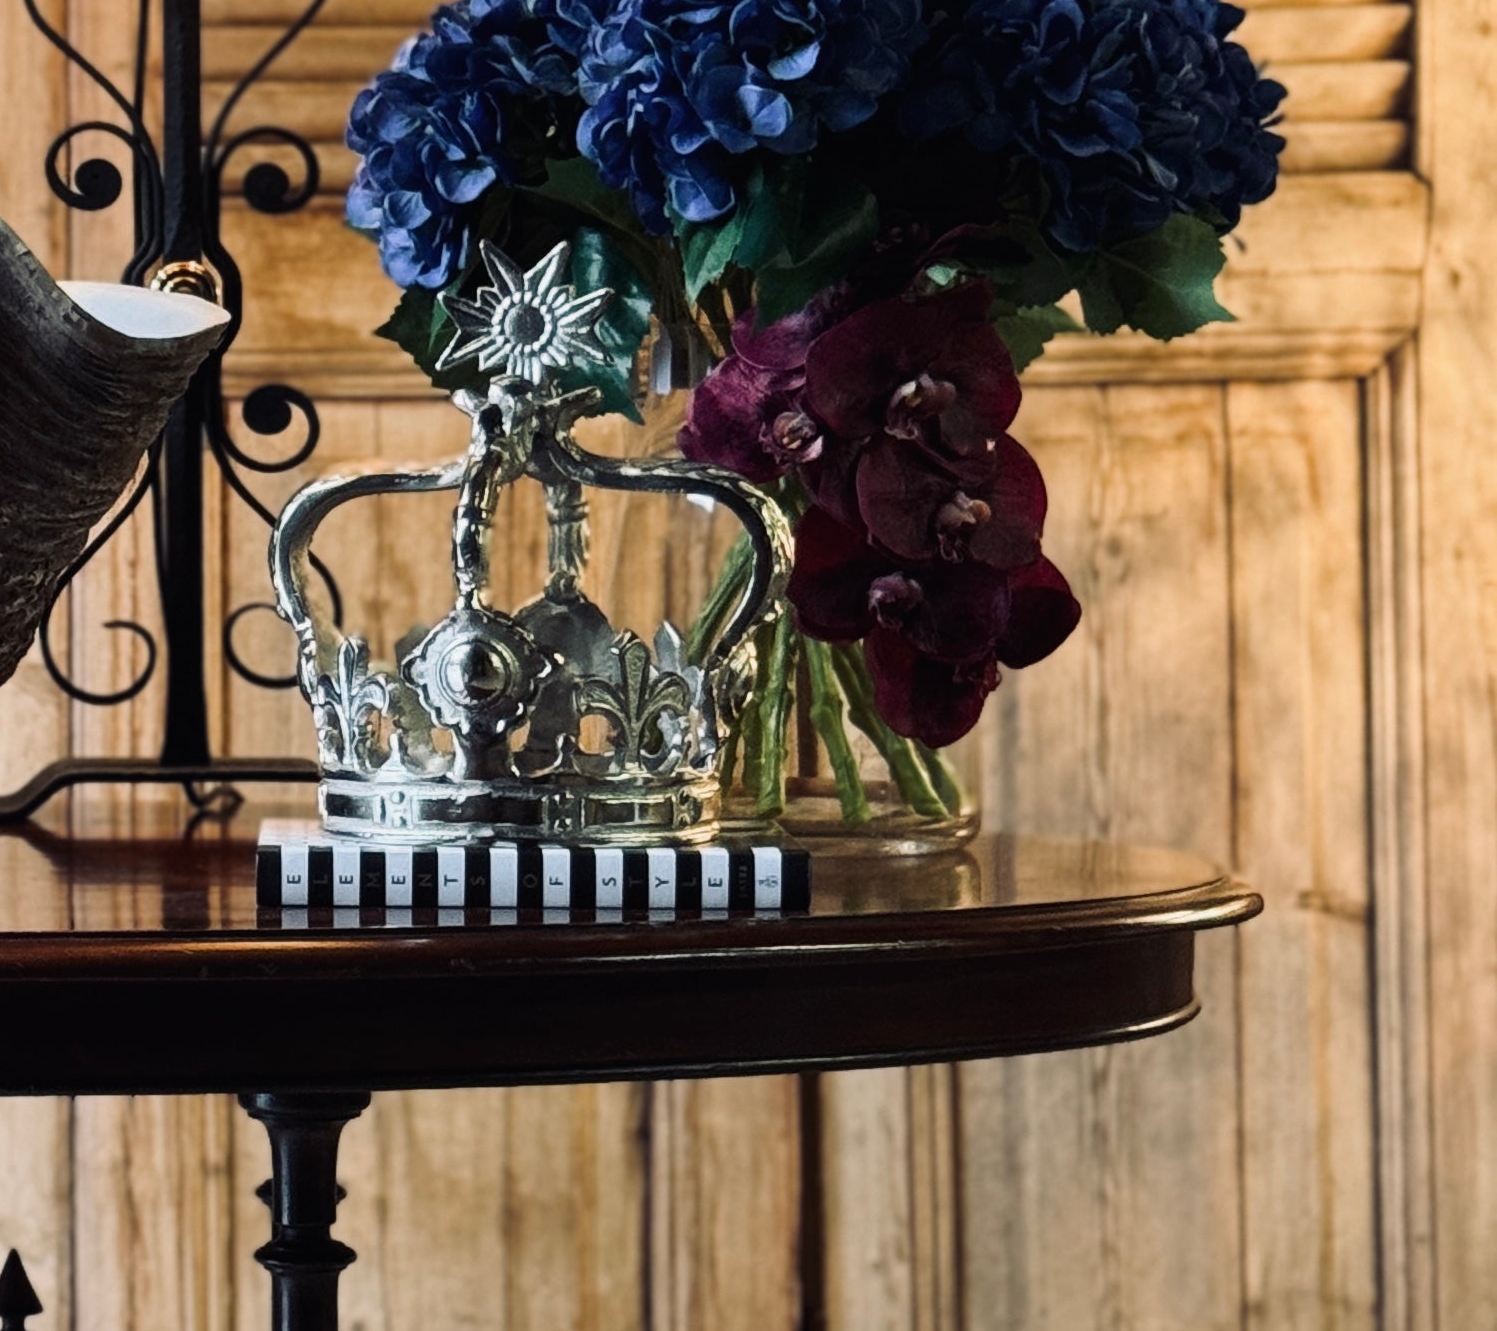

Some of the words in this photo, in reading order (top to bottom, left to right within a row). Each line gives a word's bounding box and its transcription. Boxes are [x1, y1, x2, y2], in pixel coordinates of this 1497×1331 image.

[287, 872, 487, 888] ELEMENTS
[522, 873, 565, 888] OF
[602, 875, 723, 889] STYLE
